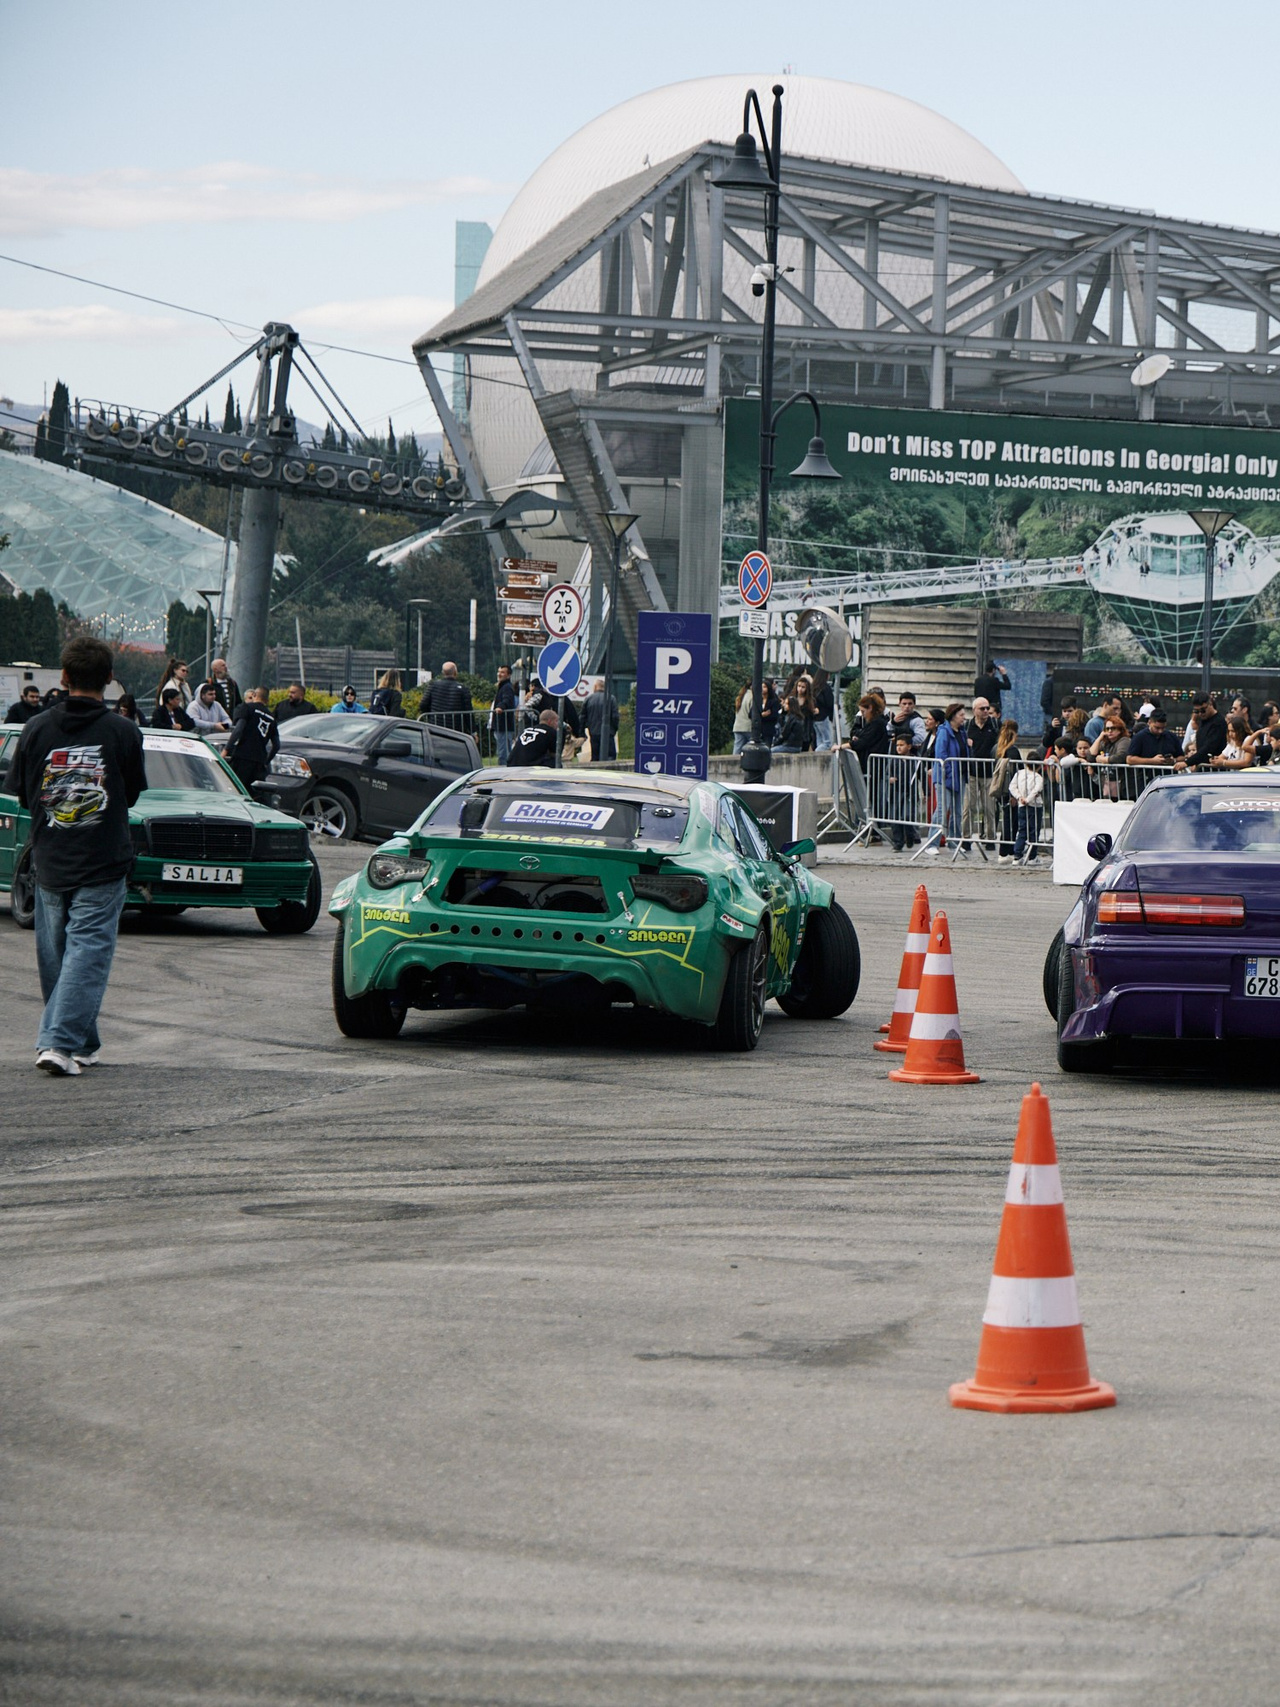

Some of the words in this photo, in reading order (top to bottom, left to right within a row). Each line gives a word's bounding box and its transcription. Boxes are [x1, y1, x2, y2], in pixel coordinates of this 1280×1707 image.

[906, 435, 953, 459] Miss
[959, 439, 996, 461] TOP
[1001, 441, 1115, 467] Attractions
[1121, 448, 1140, 469] In
[1146, 449, 1230, 474] Georgia!
[1235, 454, 1278, 478] Only
[890, 467, 989, 486] მოინახულეთ
[994, 473, 1102, 492] საქართველოს
[1106, 479, 1203, 498] გამორჩეული
[655, 647, 692, 689] P
[652, 698, 693, 715] 24/7
[514, 804, 603, 822] Rheinol
[172, 866, 233, 882] SALIA
[1247, 968, 1256, 976] GE
